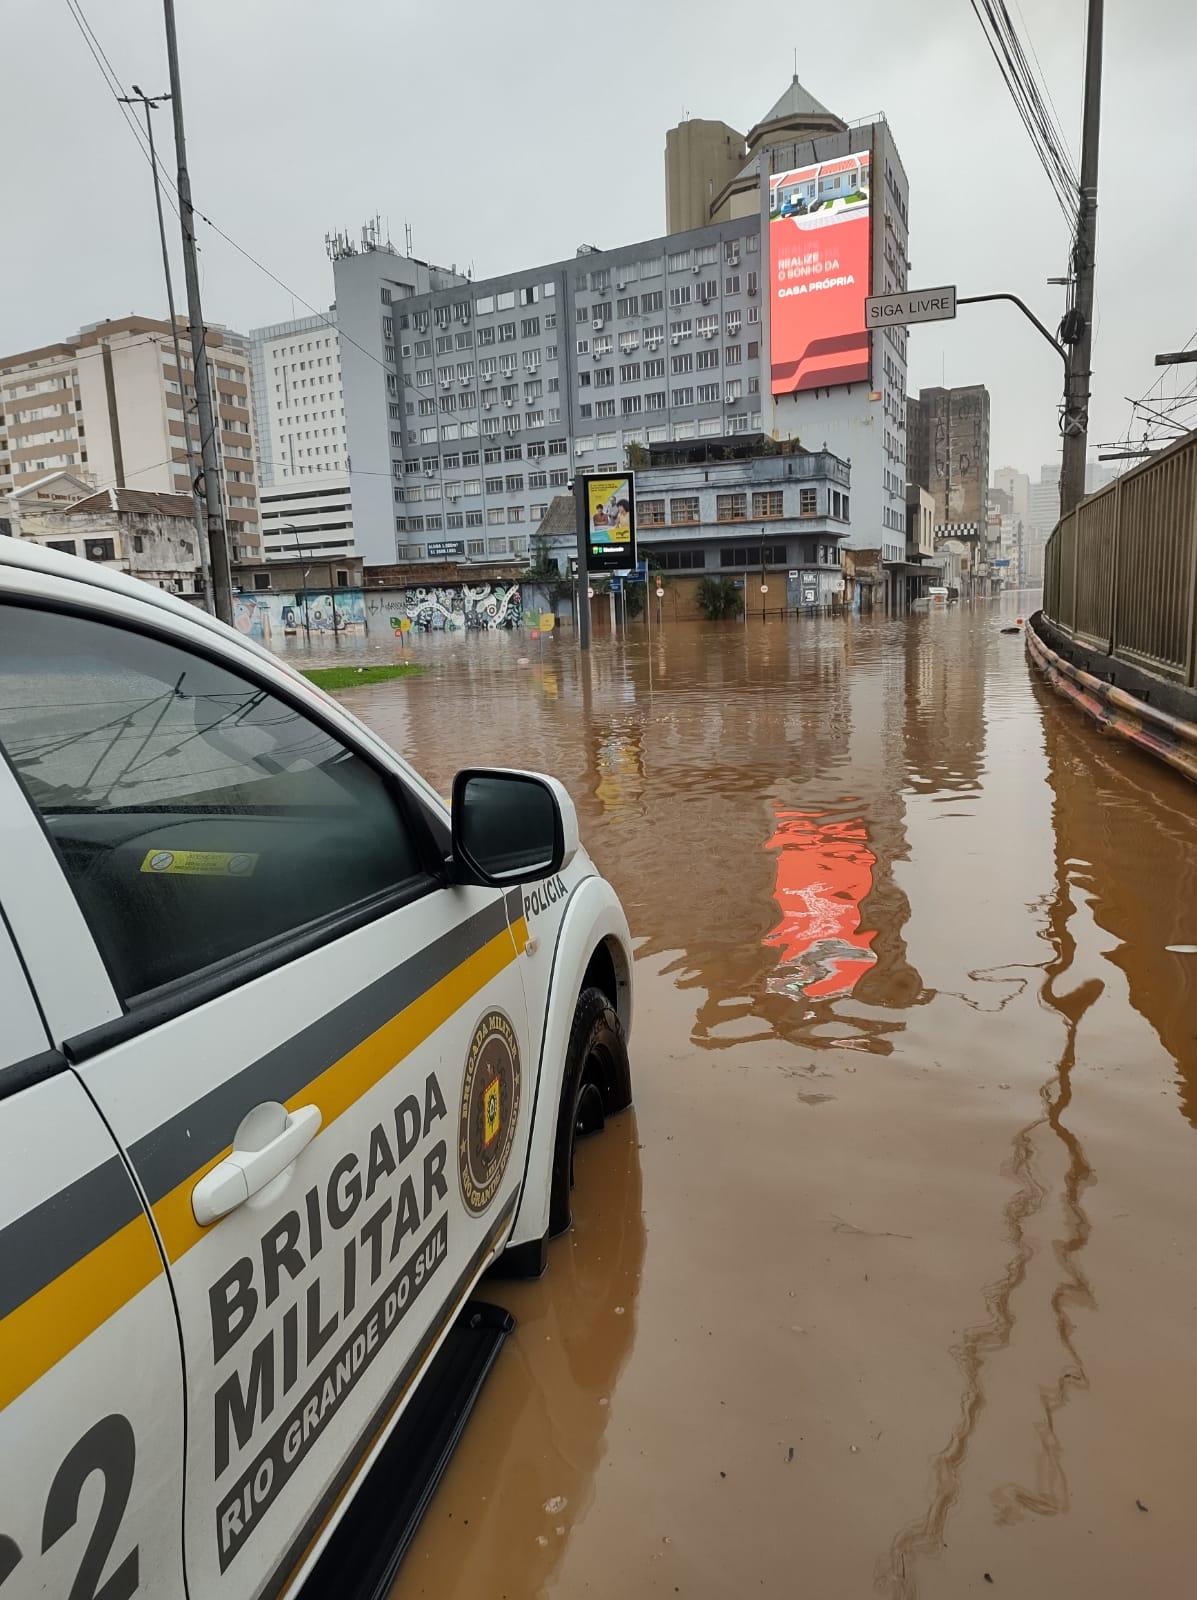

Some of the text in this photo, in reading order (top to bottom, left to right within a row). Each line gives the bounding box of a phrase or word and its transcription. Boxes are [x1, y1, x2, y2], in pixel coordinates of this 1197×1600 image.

[778, 270, 786, 282] O
[824, 258, 840, 273] DA
[778, 274, 855, 298] CASA PRÓPRIA
[871, 297, 950, 318] SIGA LIVRE
[523, 873, 569, 922] POLÍCIA
[488, 1015, 518, 1059] MILITAR
[208, 1071, 447, 1366] BRIGADA
[215, 1139, 448, 1482] MILITAR
[221, 1233, 445, 1553] RIO GRANDE DO SUL
[0, 1413, 140, 1600] 2
